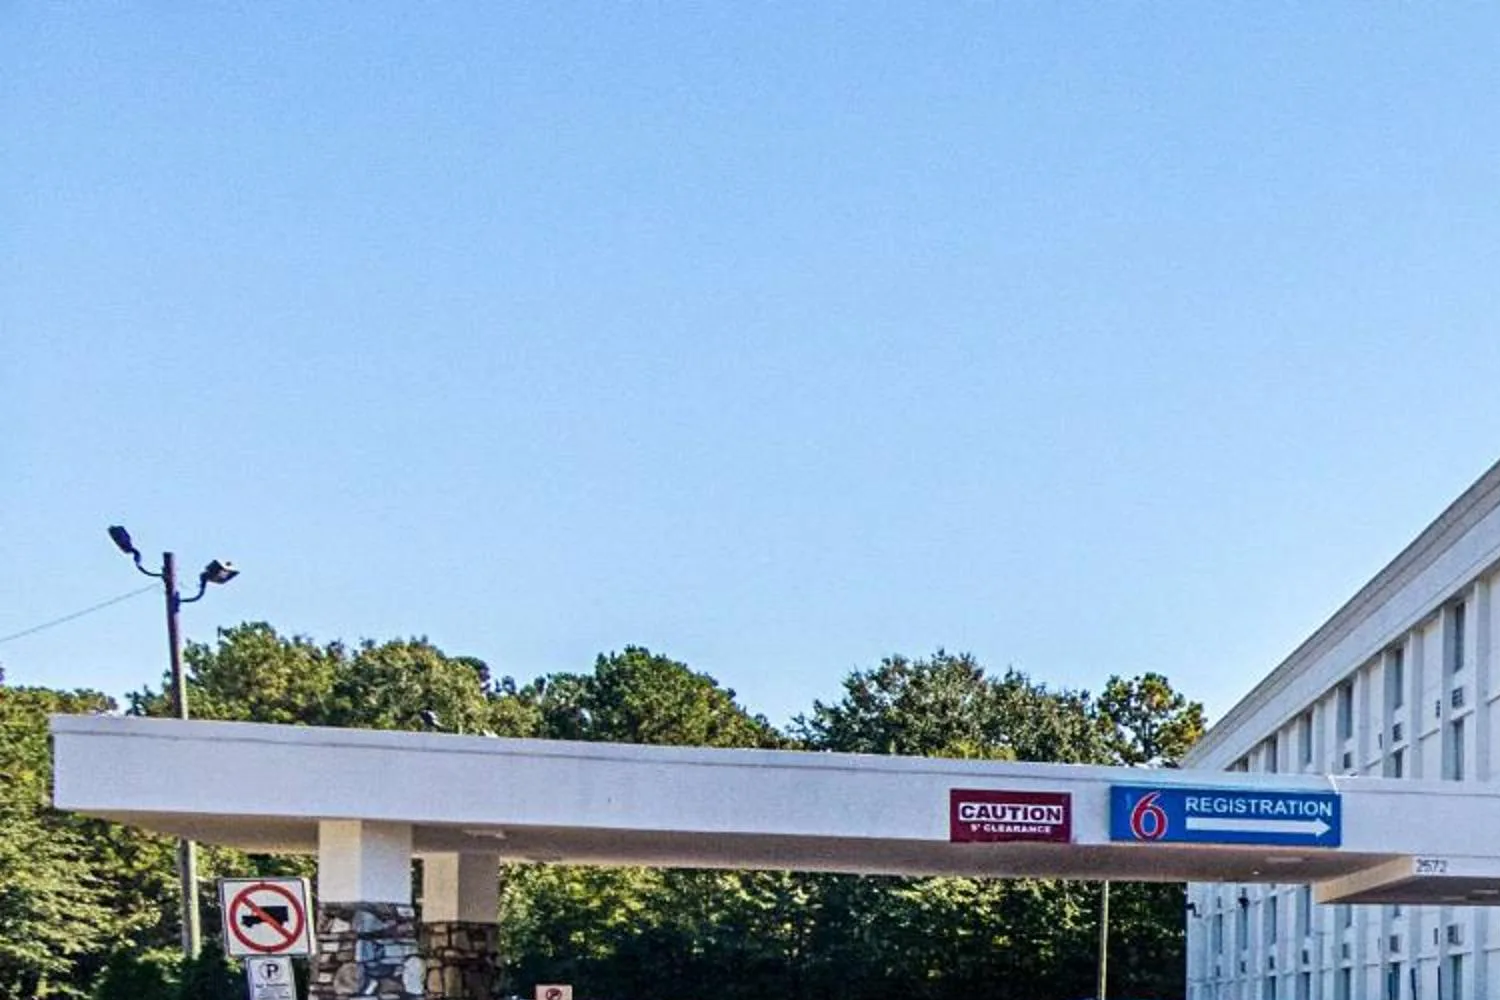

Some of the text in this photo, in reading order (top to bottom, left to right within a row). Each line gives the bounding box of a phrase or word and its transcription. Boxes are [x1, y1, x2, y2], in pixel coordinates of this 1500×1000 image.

[960, 804, 1062, 822] CAUTION
[1129, 790, 1169, 841] 6
[1184, 796, 1334, 817] REGISTRATION
[982, 823, 1052, 834] CLEARANCE
